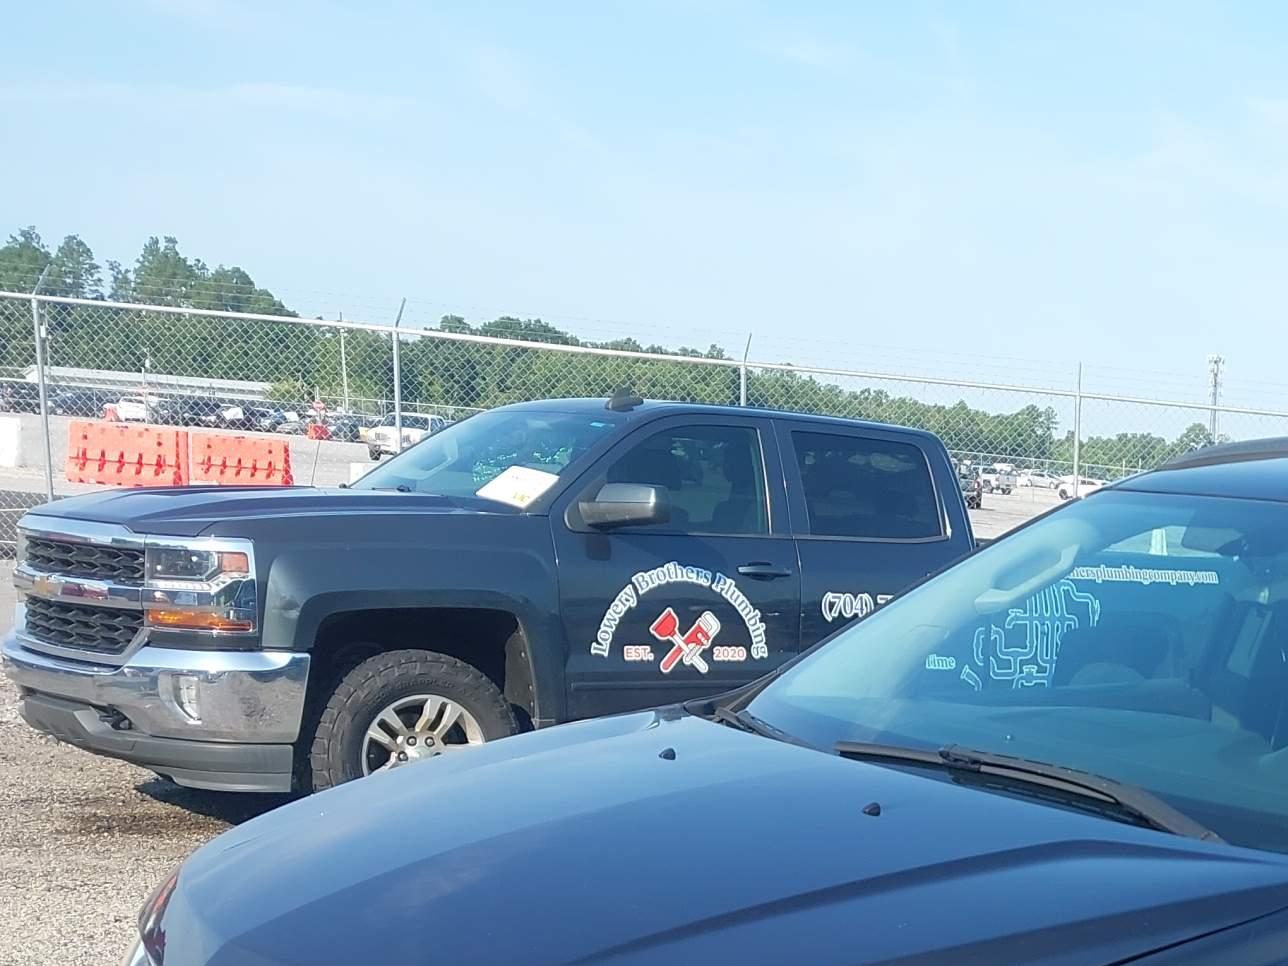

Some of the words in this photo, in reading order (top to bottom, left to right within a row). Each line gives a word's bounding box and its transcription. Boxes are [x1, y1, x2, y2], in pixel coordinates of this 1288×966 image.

[591, 584, 638, 658] Lowery
[632, 561, 712, 595] Brothers
[711, 573, 768, 659] Plumbing
[624, 646, 654, 660] EST.
[713, 647, 746, 661] 2020
